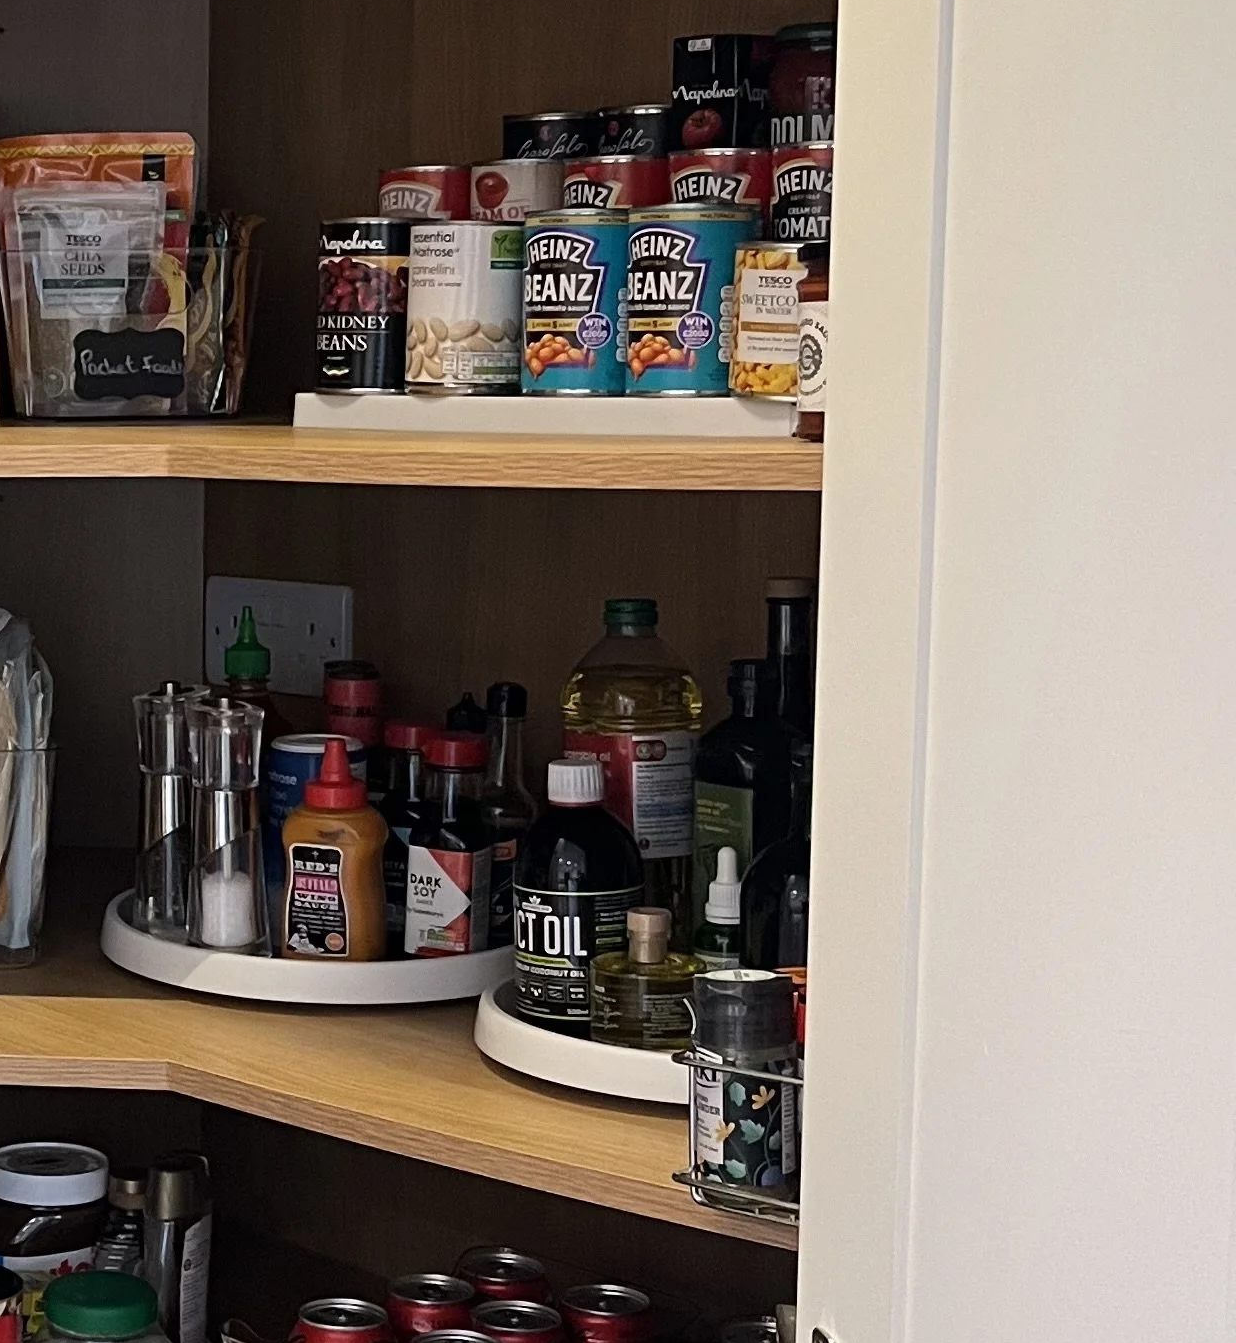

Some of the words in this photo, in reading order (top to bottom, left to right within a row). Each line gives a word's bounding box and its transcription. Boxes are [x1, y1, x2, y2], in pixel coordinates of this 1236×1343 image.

[673, 80, 740, 104] Napolina
[676, 178, 737, 201] HEINZ
[381, 191, 429, 212] HEINZ
[66, 234, 102, 247] TESCO
[631, 235, 686, 261] HEINZ
[530, 238, 586, 264] HEINZ
[60, 264, 106, 276] SEEDS
[524, 273, 594, 302] BEANZ
[628, 270, 695, 301] BEANZ
[759, 275, 793, 288] TESCO
[741, 293, 797, 308] SWEETCO
[328, 315, 390, 330] KIDNEY
[584, 318, 607, 327] WIN
[684, 317, 708, 326] WIN
[316, 335, 368, 351] BEANS
[410, 873, 442, 888] DARK
[413, 886, 437, 899] SOY
[515, 911, 537, 951] CT
[543, 914, 588, 957] OIL
